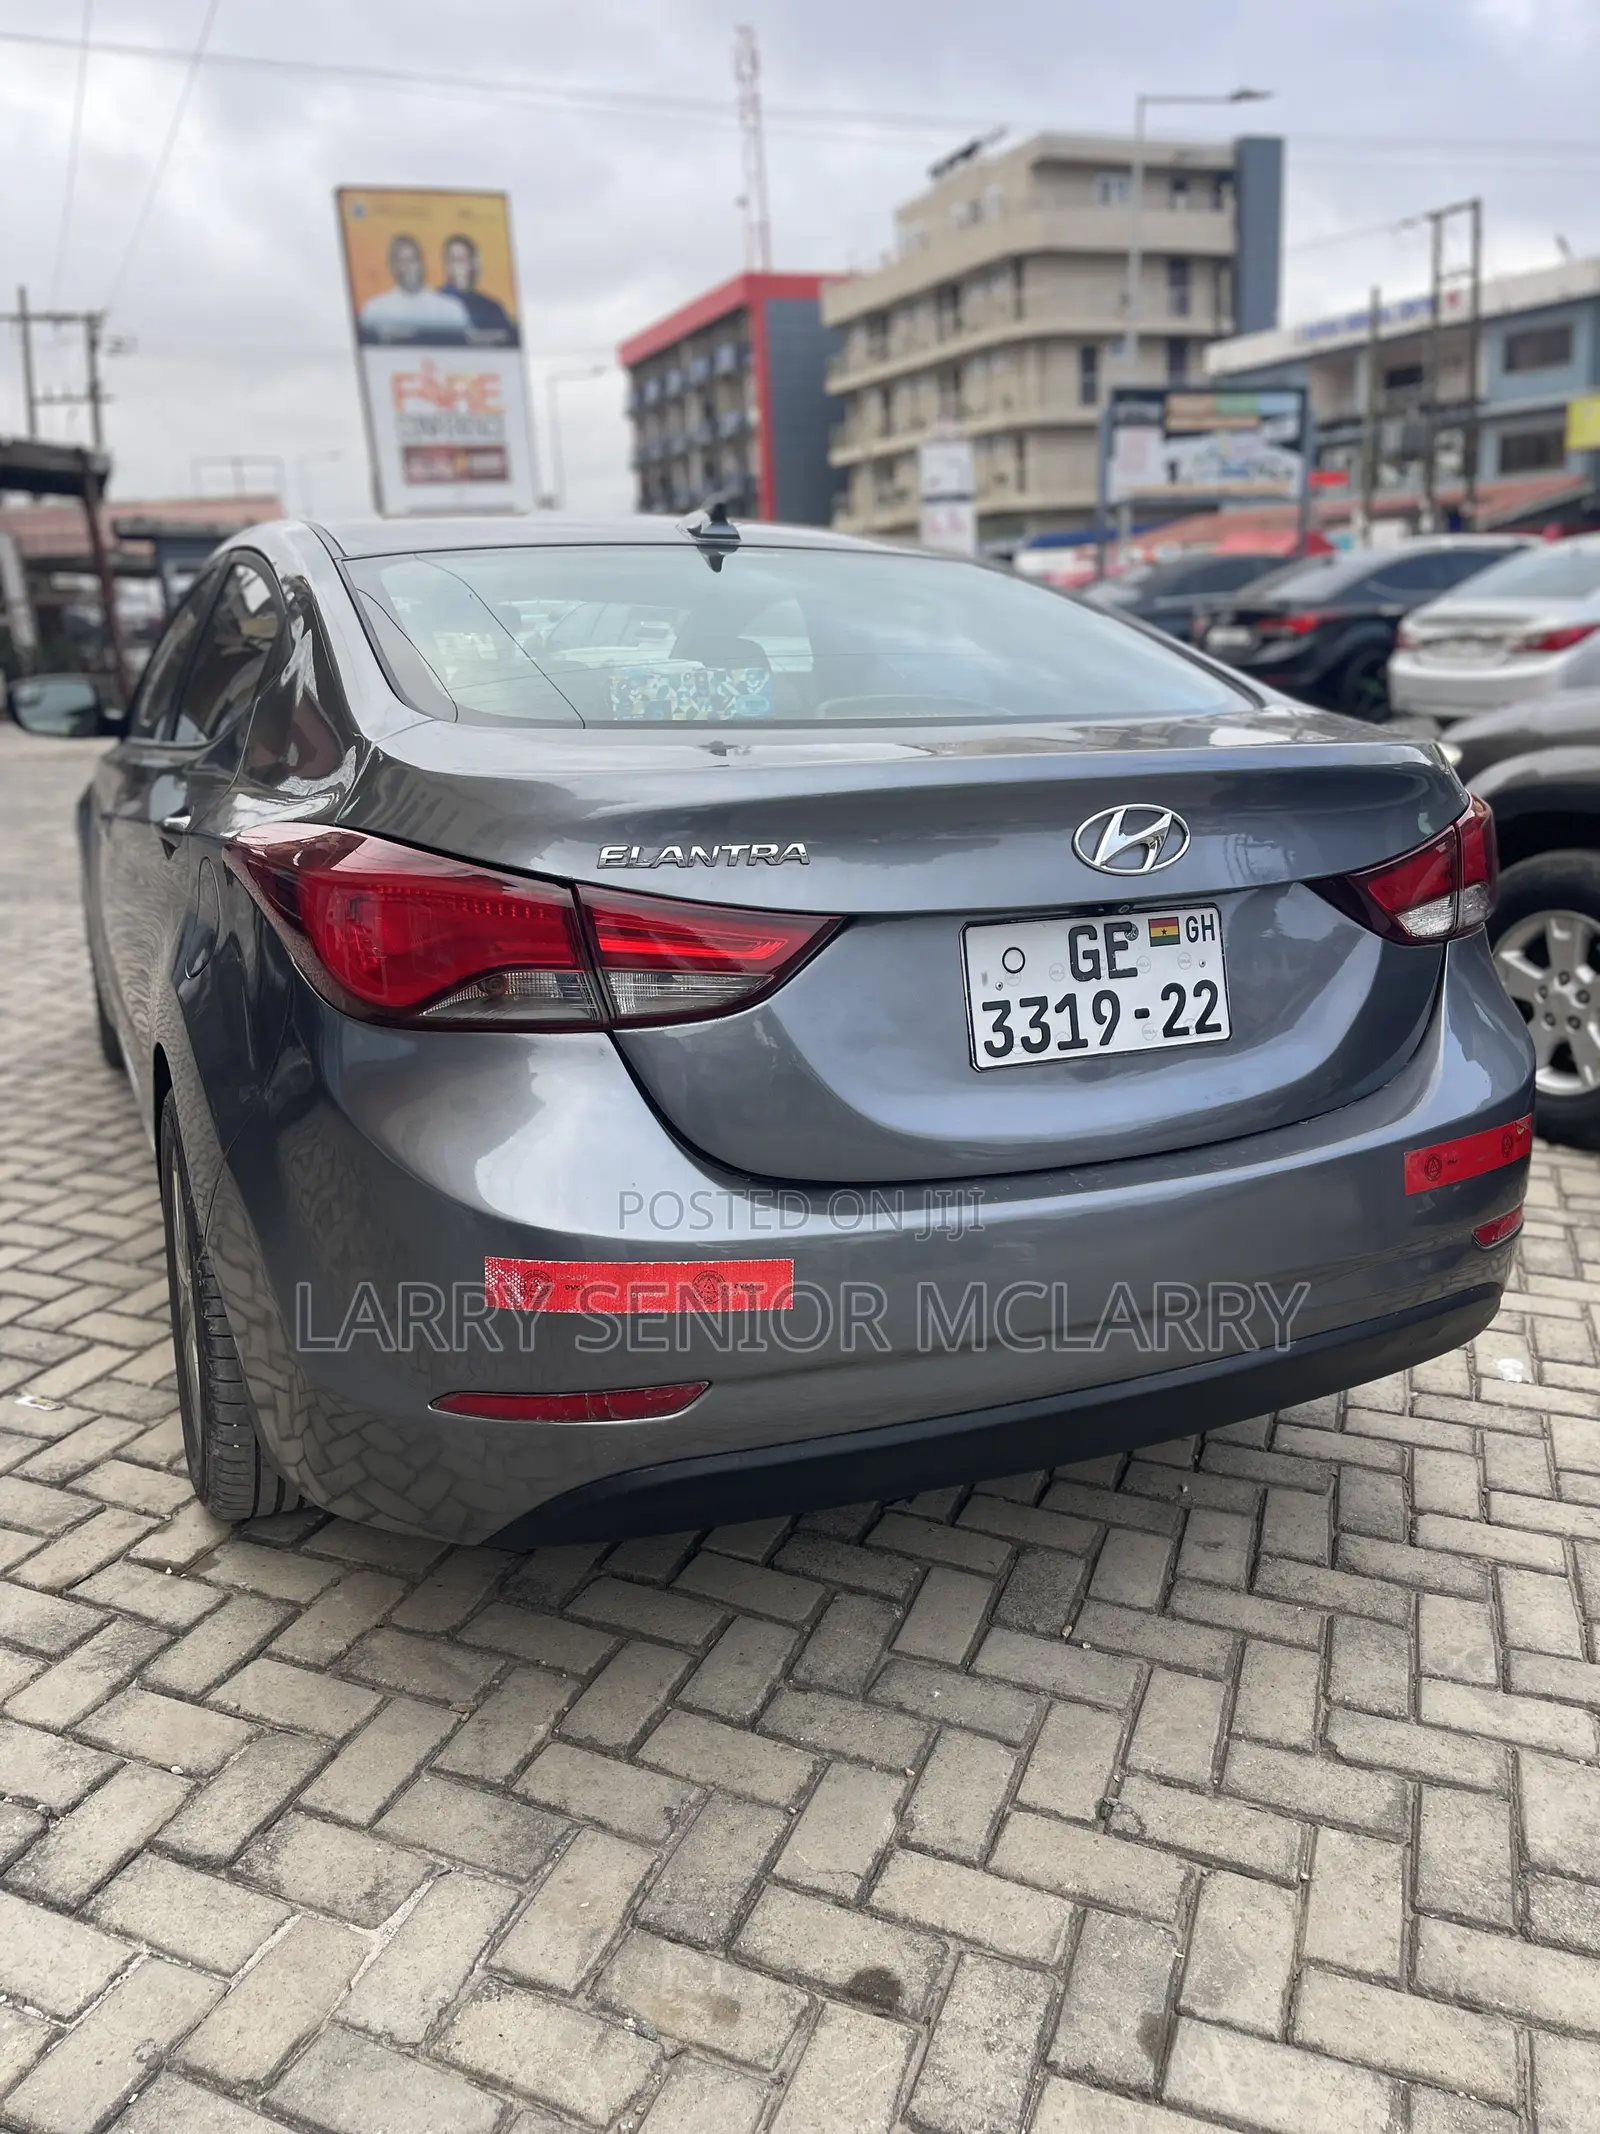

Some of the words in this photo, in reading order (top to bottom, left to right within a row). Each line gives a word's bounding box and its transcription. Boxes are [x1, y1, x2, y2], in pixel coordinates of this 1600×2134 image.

[597, 841, 810, 870] ELANTRA
[1068, 921, 1138, 982] GE
[1186, 913, 1215, 943] GH
[982, 979, 1222, 1058] 3319-22
